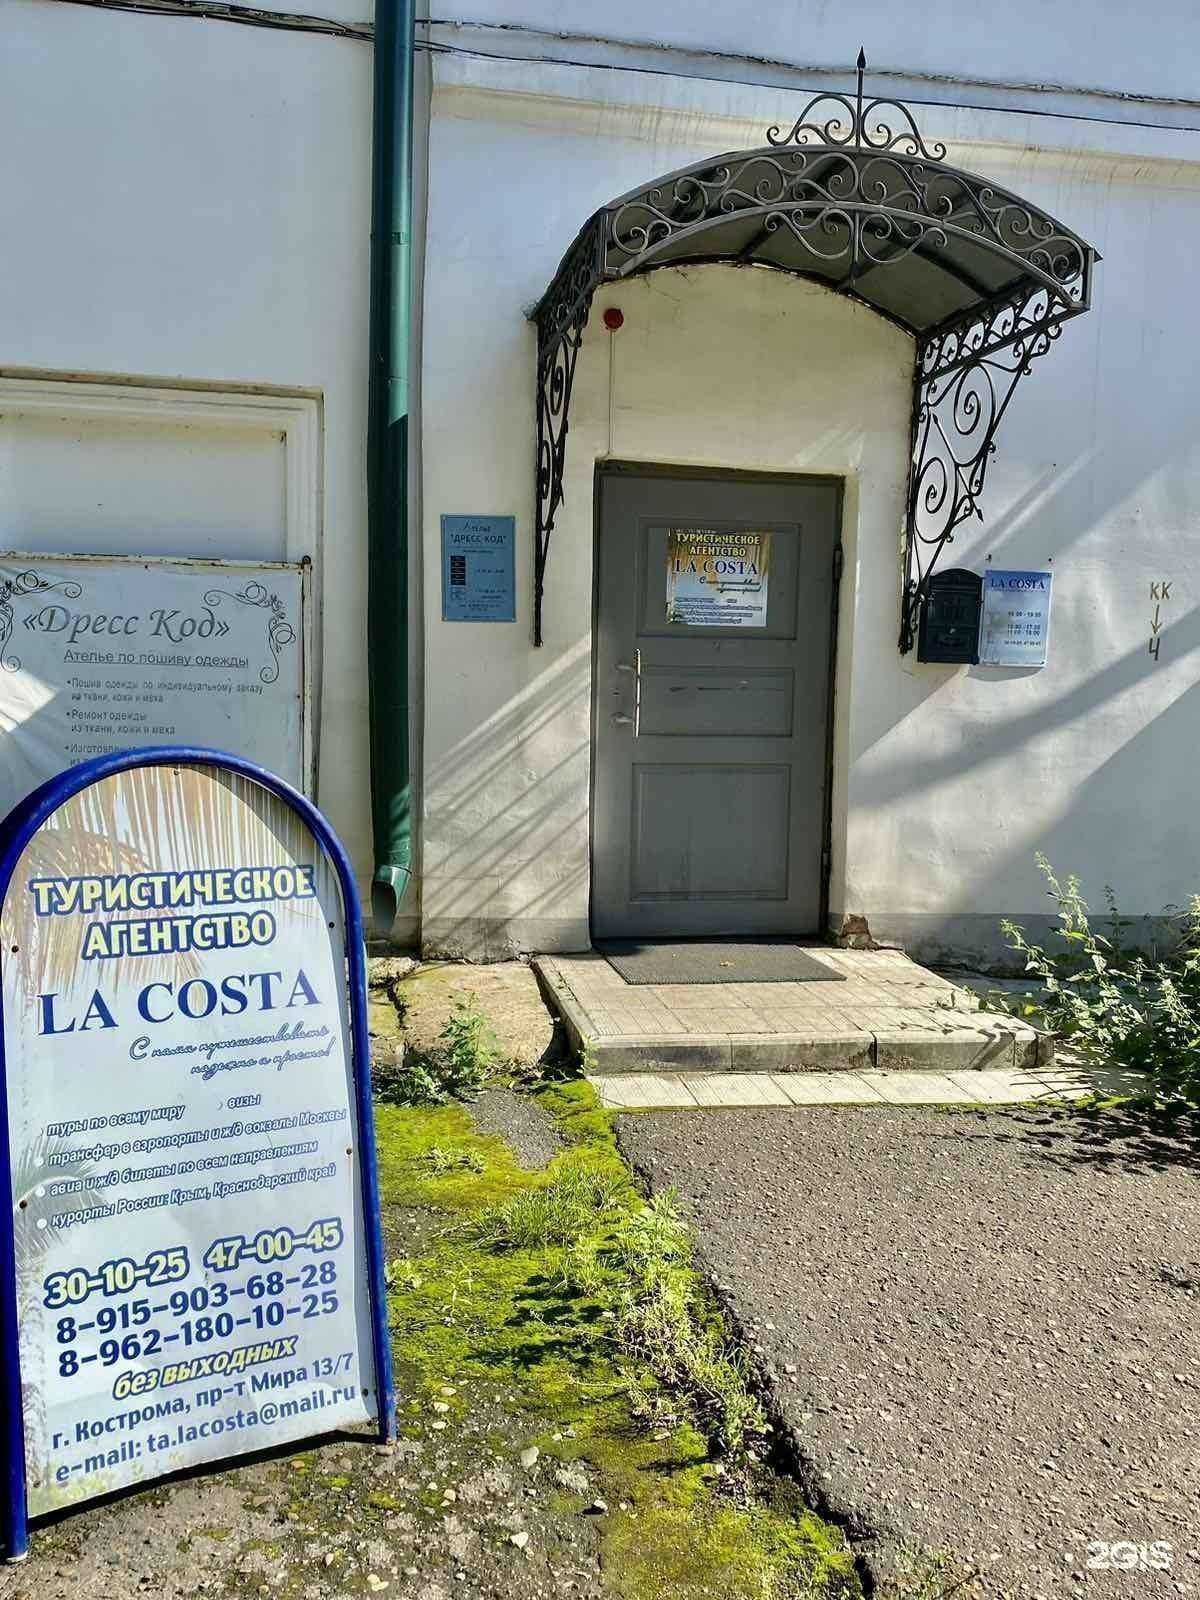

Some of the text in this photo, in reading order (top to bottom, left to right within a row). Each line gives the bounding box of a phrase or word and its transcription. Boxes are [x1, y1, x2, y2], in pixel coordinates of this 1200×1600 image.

[677, 532, 761, 545] ТУРИСТИЧЕСКОЕ
[689, 546, 747, 557] АГЕНТСТВО
[674, 559, 758, 575] LA COSTA
[991, 579, 1046, 590] LA COSTA
[22, 605, 231, 644] «Дресс Код»
[64, 649, 249, 668] Ателье по пошиву одежды
[71, 709, 107, 721] Ремонт
[29, 865, 316, 916] ТУРИСТИЧЕСКОЕ
[81, 910, 276, 960] АГЕНТСТВО
[37, 969, 322, 1035] LA COSTA
[128, 1021, 330, 1061] С нами путешествовать
[190, 1037, 336, 1081] надежно и просто!
[47, 1105, 186, 1138] туры по всему миру
[227, 1093, 262, 1110] визы
[49, 1108, 347, 1167] трансфер в аэропорты и ж/д вокзалы Москвы
[50, 1141, 319, 1197] авиа и ж/д билеты по всем направлениям
[51, 1162, 337, 1229] курорты России: Крым, Краснодарский край
[43, 1217, 344, 1309] 30-10-25 47-00-45
[56, 1260, 338, 1345] 8-915-903-68-28
[58, 1289, 339, 1378] 8-962-180-10-25
[113, 1335, 299, 1401] без выходных
[52, 1352, 354, 1450] г. Кострома, пр-т Мира 13/7
[55, 1385, 357, 1483] e-mail: ta.lacosta@mail.ru
